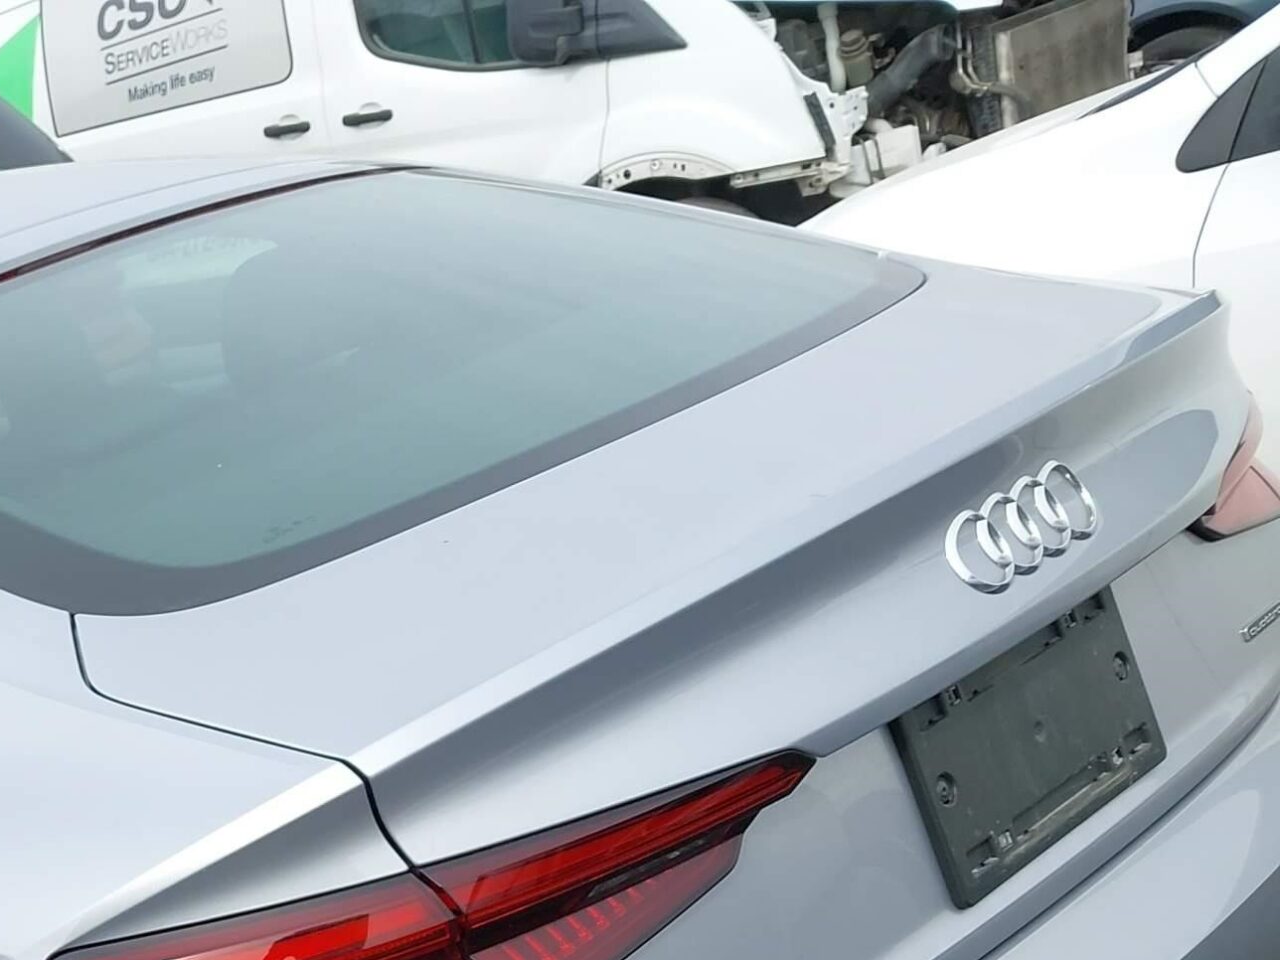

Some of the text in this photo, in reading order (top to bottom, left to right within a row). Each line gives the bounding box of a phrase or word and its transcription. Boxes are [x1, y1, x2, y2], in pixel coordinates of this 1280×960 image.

[128, 67, 215, 103] Making life easy
